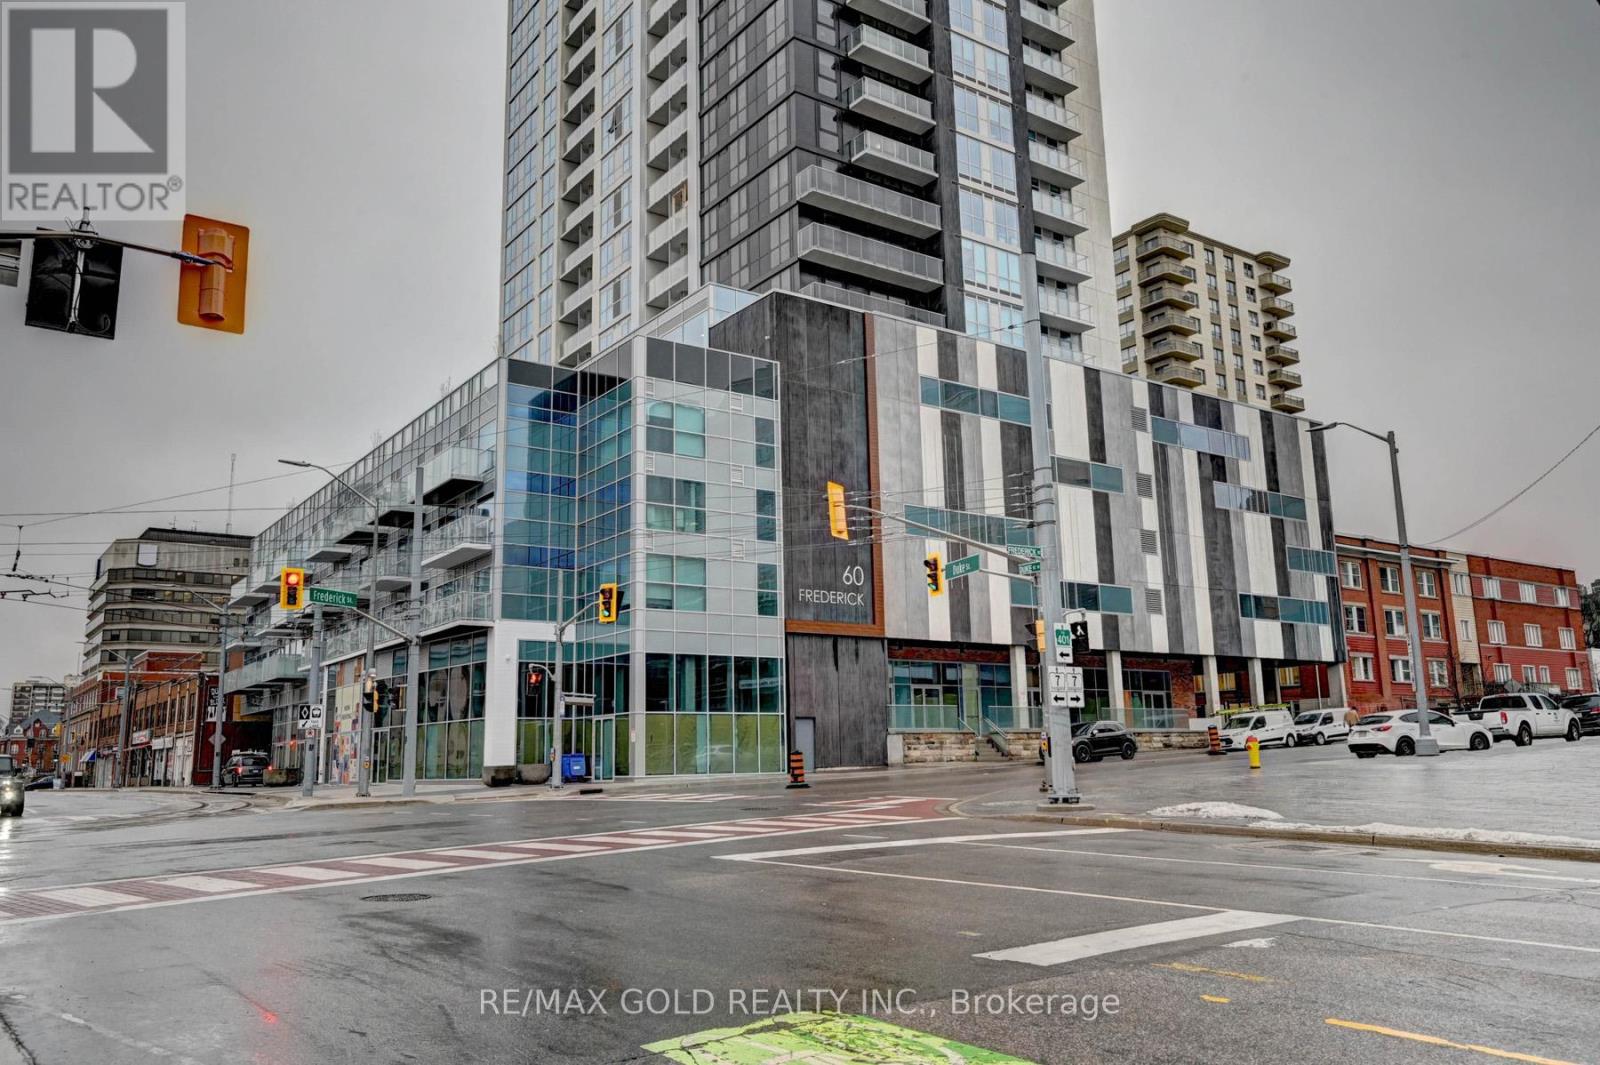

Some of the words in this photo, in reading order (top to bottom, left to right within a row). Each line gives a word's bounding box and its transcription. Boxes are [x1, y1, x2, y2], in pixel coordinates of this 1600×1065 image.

[843, 565, 864, 586] 60
[953, 562, 965, 576] Duke
[313, 590, 346, 604] Frederick
[799, 588, 864, 606] FREDERICK
[1057, 634, 1070, 645] 401
[1055, 674, 1060, 687] 7
[1072, 675, 1077, 687] 7
